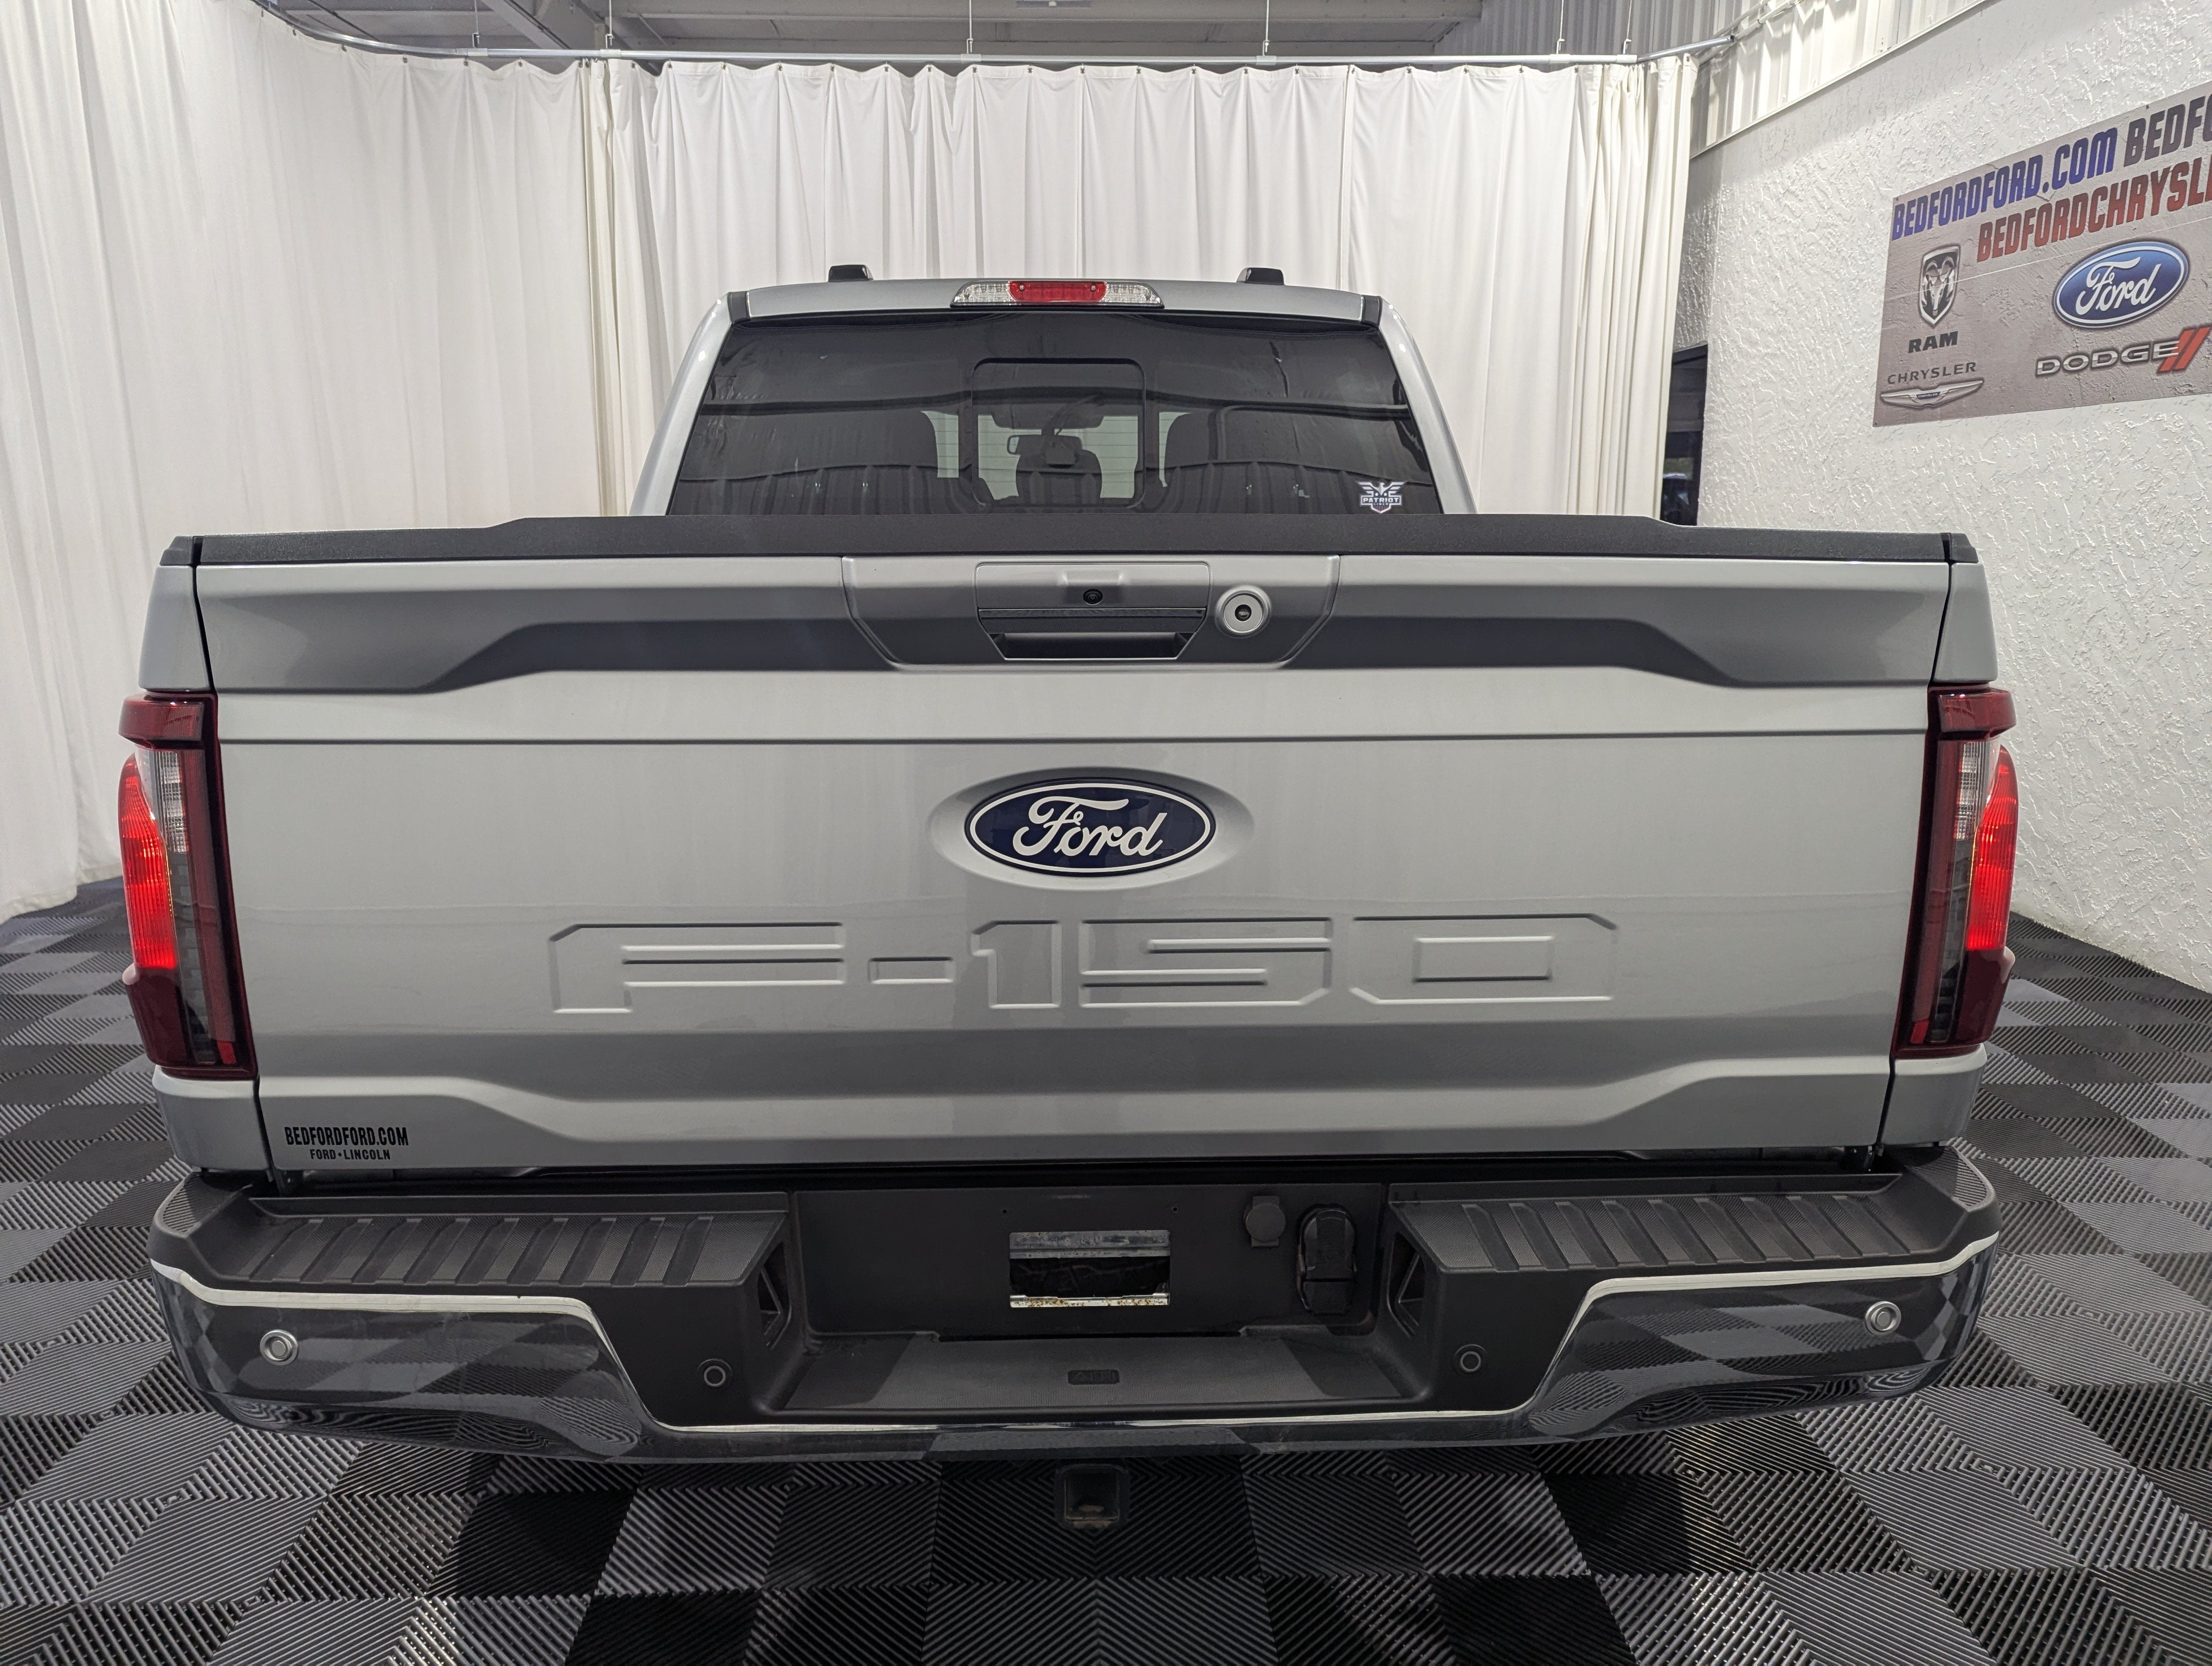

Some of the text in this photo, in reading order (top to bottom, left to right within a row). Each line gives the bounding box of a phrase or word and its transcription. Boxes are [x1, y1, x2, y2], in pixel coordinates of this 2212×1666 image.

[1892, 127, 2118, 240] BEDFORDFORD.COM
[2075, 257, 2162, 315] Ford
[1908, 331, 1958, 354] RAM
[2036, 339, 2180, 377] DODGE
[1887, 362, 1976, 385] CHRYSLER
[1012, 796, 1168, 856] Ford
[550, 915, 1618, 1013] F-150
[284, 1126, 409, 1145] BEDFORDFORD.COM
[310, 1149, 390, 1159] FORD LINCOLN
